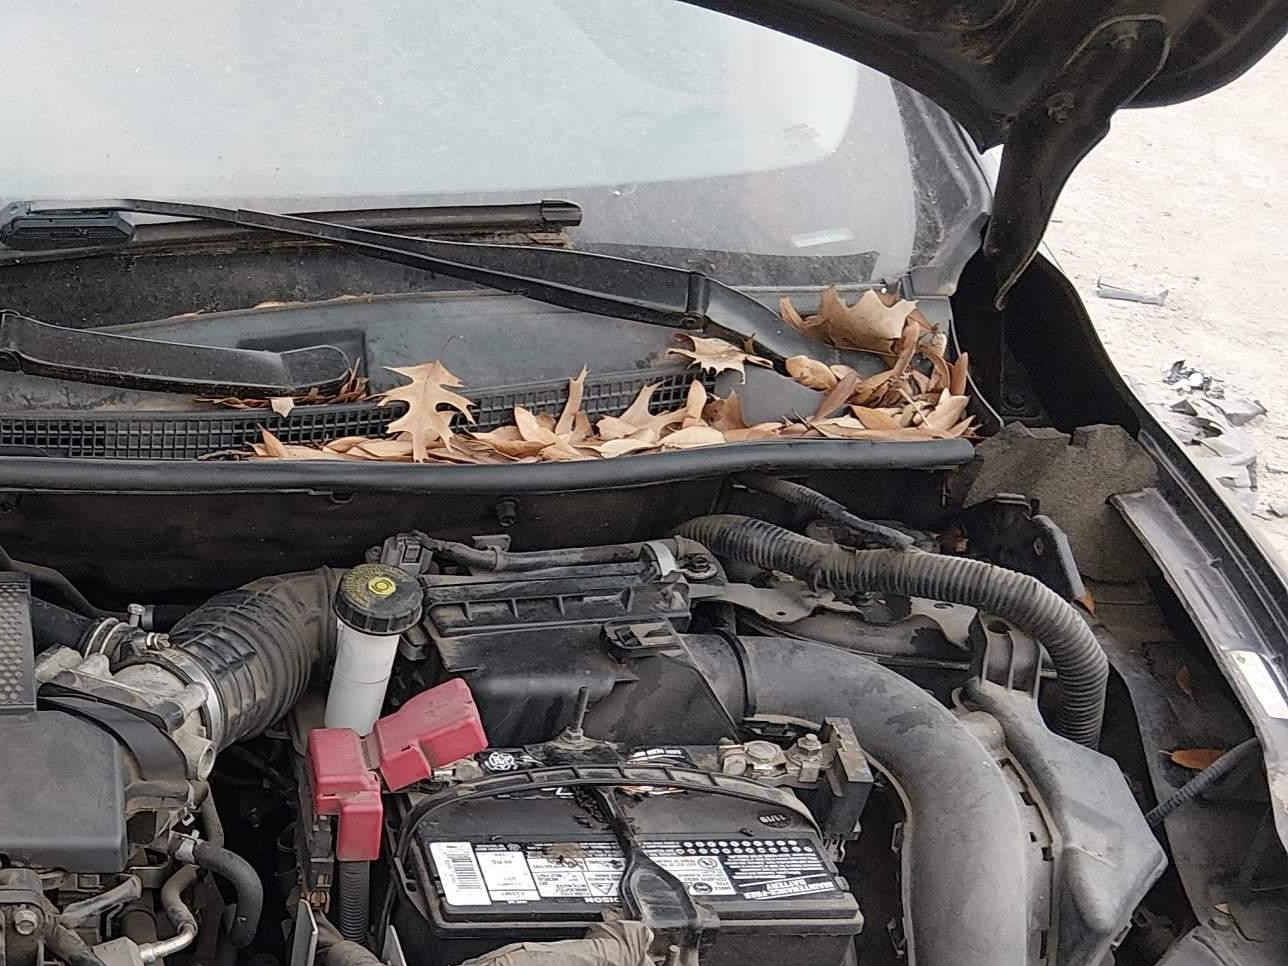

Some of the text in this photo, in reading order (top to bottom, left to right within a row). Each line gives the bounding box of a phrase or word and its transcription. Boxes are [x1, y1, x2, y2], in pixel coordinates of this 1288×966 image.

[759, 814, 787, 823] 11/19
[765, 879, 806, 889] BATTERY
[742, 881, 834, 899] MAINTENANCE-FREE
